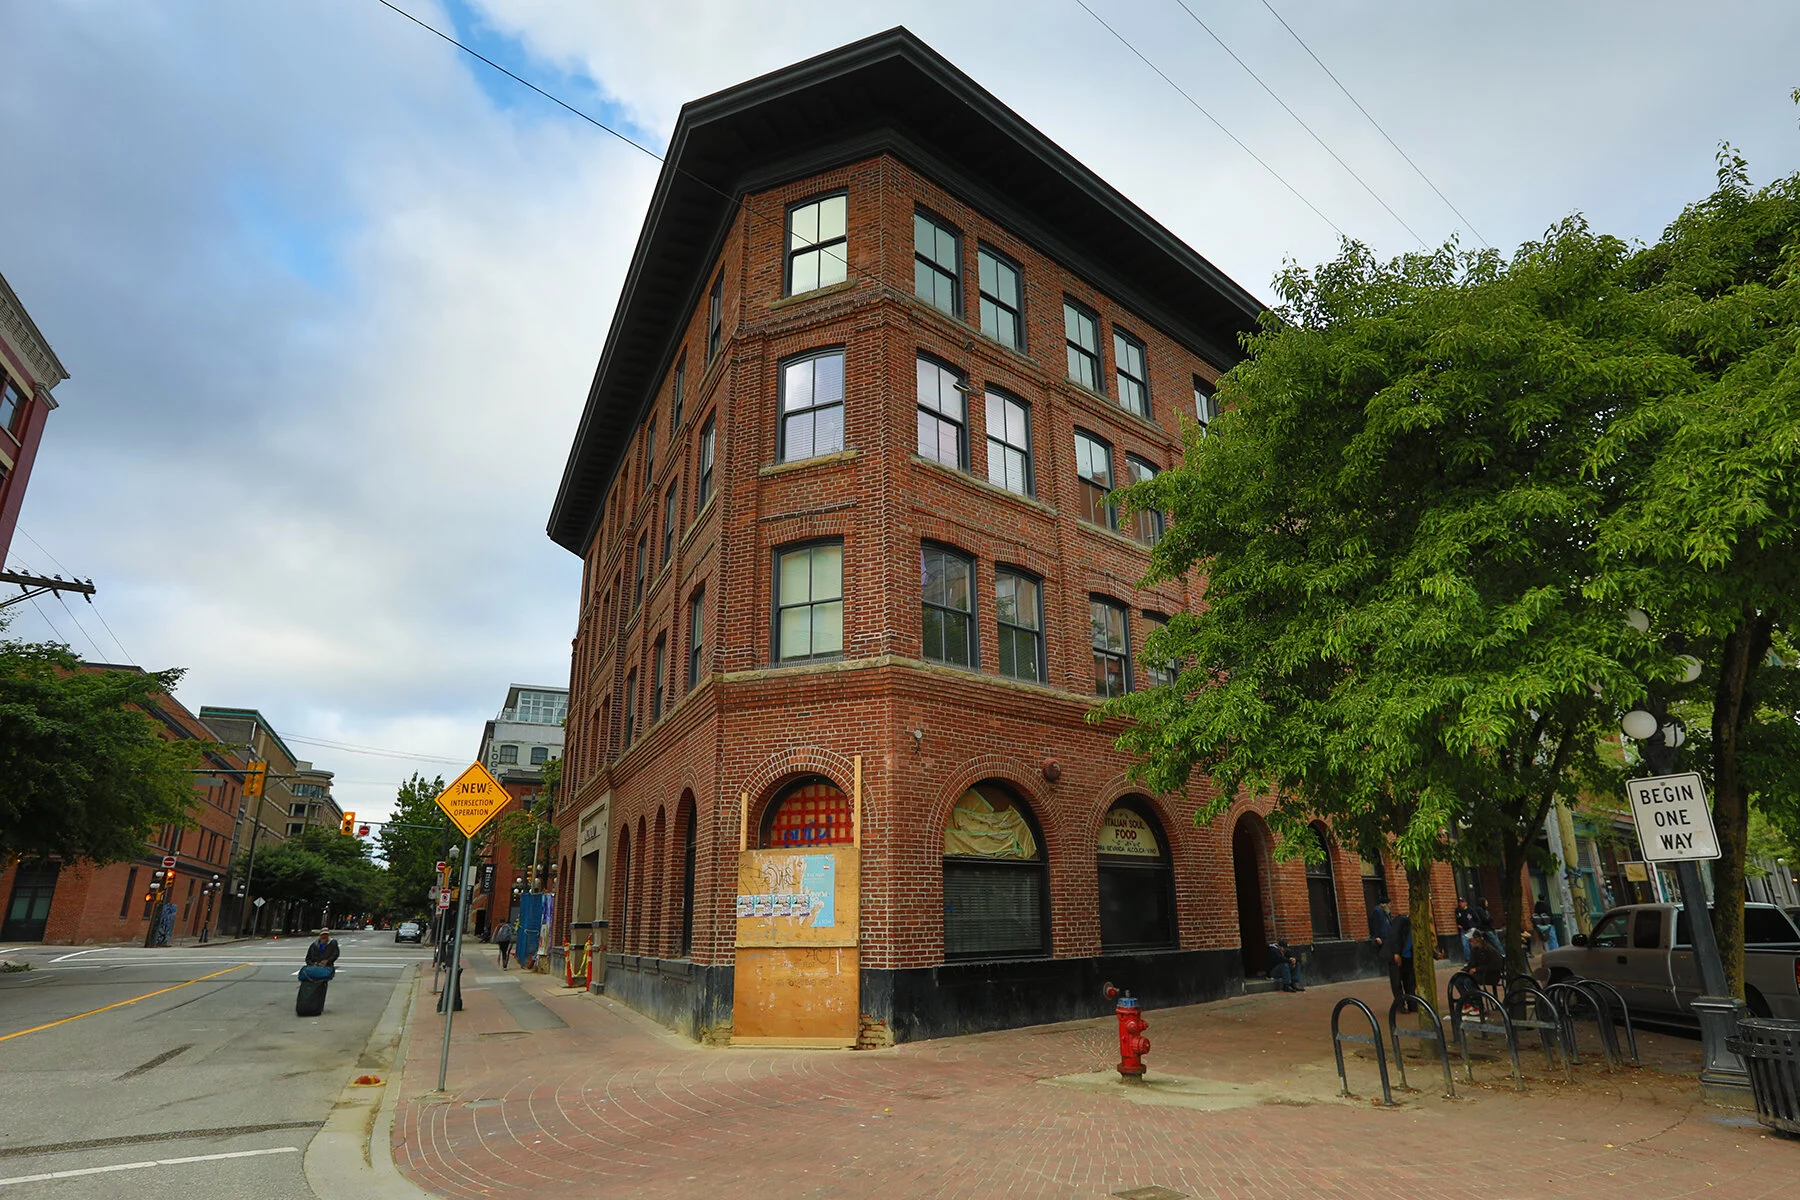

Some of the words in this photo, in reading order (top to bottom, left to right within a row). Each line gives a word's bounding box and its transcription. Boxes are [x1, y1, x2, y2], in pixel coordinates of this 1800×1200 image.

[490, 746, 498, 777] LOGG
[461, 783, 487, 794] NEW
[1639, 785, 1694, 805] BEGIN
[450, 799, 494, 807] INTERSECTION
[1104, 817, 1128, 828] ITALIAN
[1128, 819, 1145, 830] SOUL
[1654, 809, 1691, 828] ONE
[1115, 829, 1137, 840] FOOD
[1660, 832, 1693, 850] WAY
